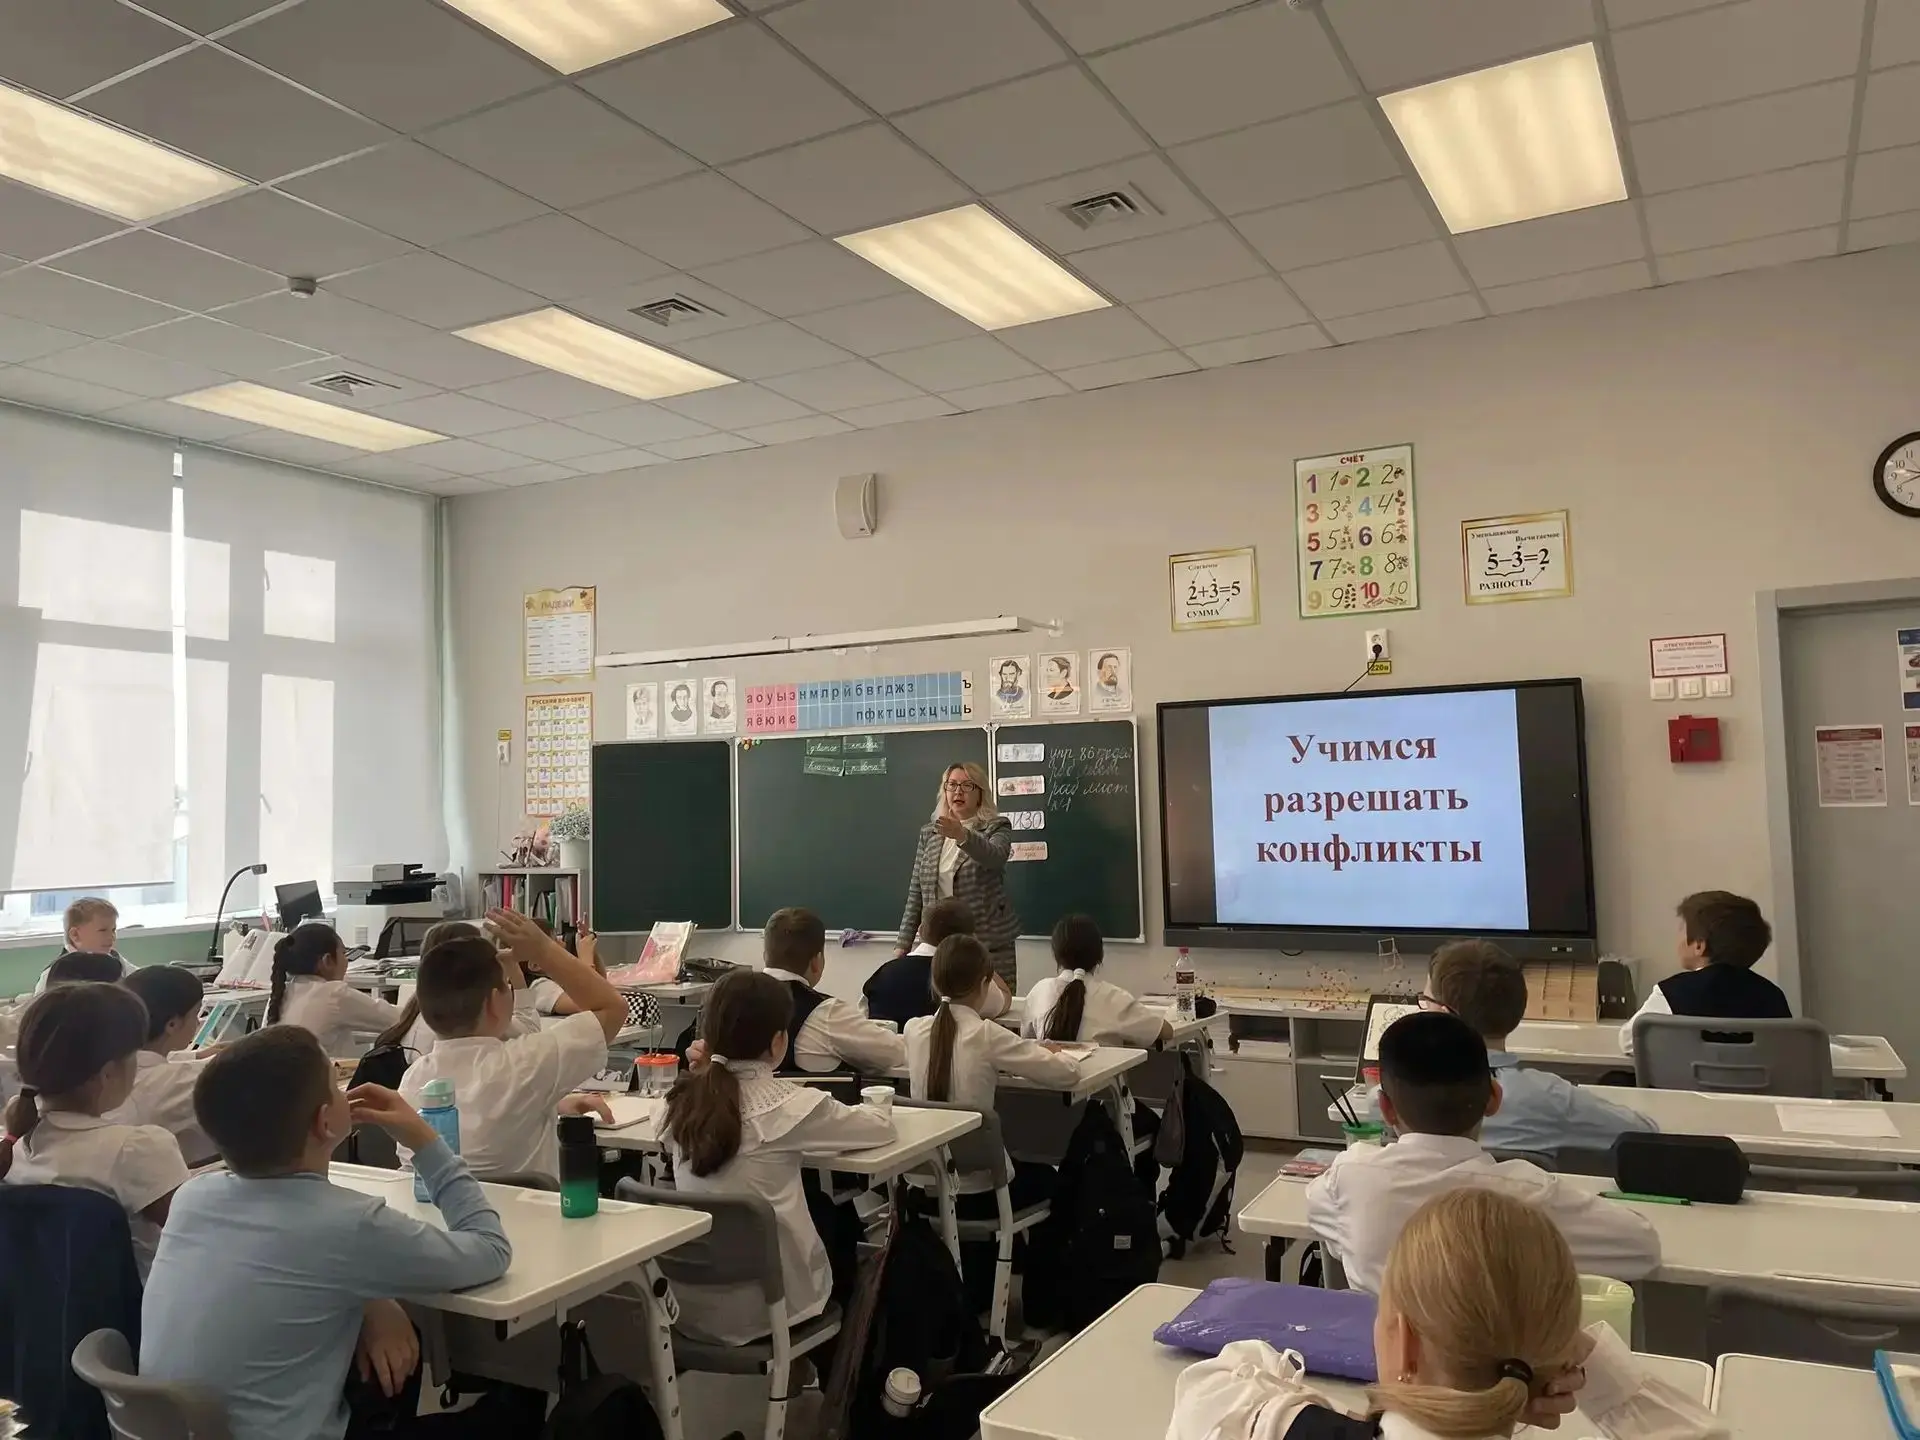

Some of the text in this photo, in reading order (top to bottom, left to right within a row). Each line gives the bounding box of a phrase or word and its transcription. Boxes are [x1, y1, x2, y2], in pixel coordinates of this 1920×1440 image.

[1895, 460, 1906, 469] 10
[1906, 449, 1914, 459] 11
[1307, 464, 1394, 494] 1 1 2 2
[1306, 493, 1394, 523] 3 3 4 4
[1307, 523, 1395, 552] 5 5 6 6
[1310, 552, 1397, 581] 7 7 8 8
[1188, 580, 1241, 601] 2+3=5
[1308, 581, 1408, 611] 9 9 10 10
[1479, 578, 1532, 591] РАЗНОСТЬ
[1186, 608, 1220, 619] СУММА
[1286, 734, 1437, 764] Учимся
[1264, 788, 1469, 822] разрешать
[1256, 833, 1482, 871] конфликты
